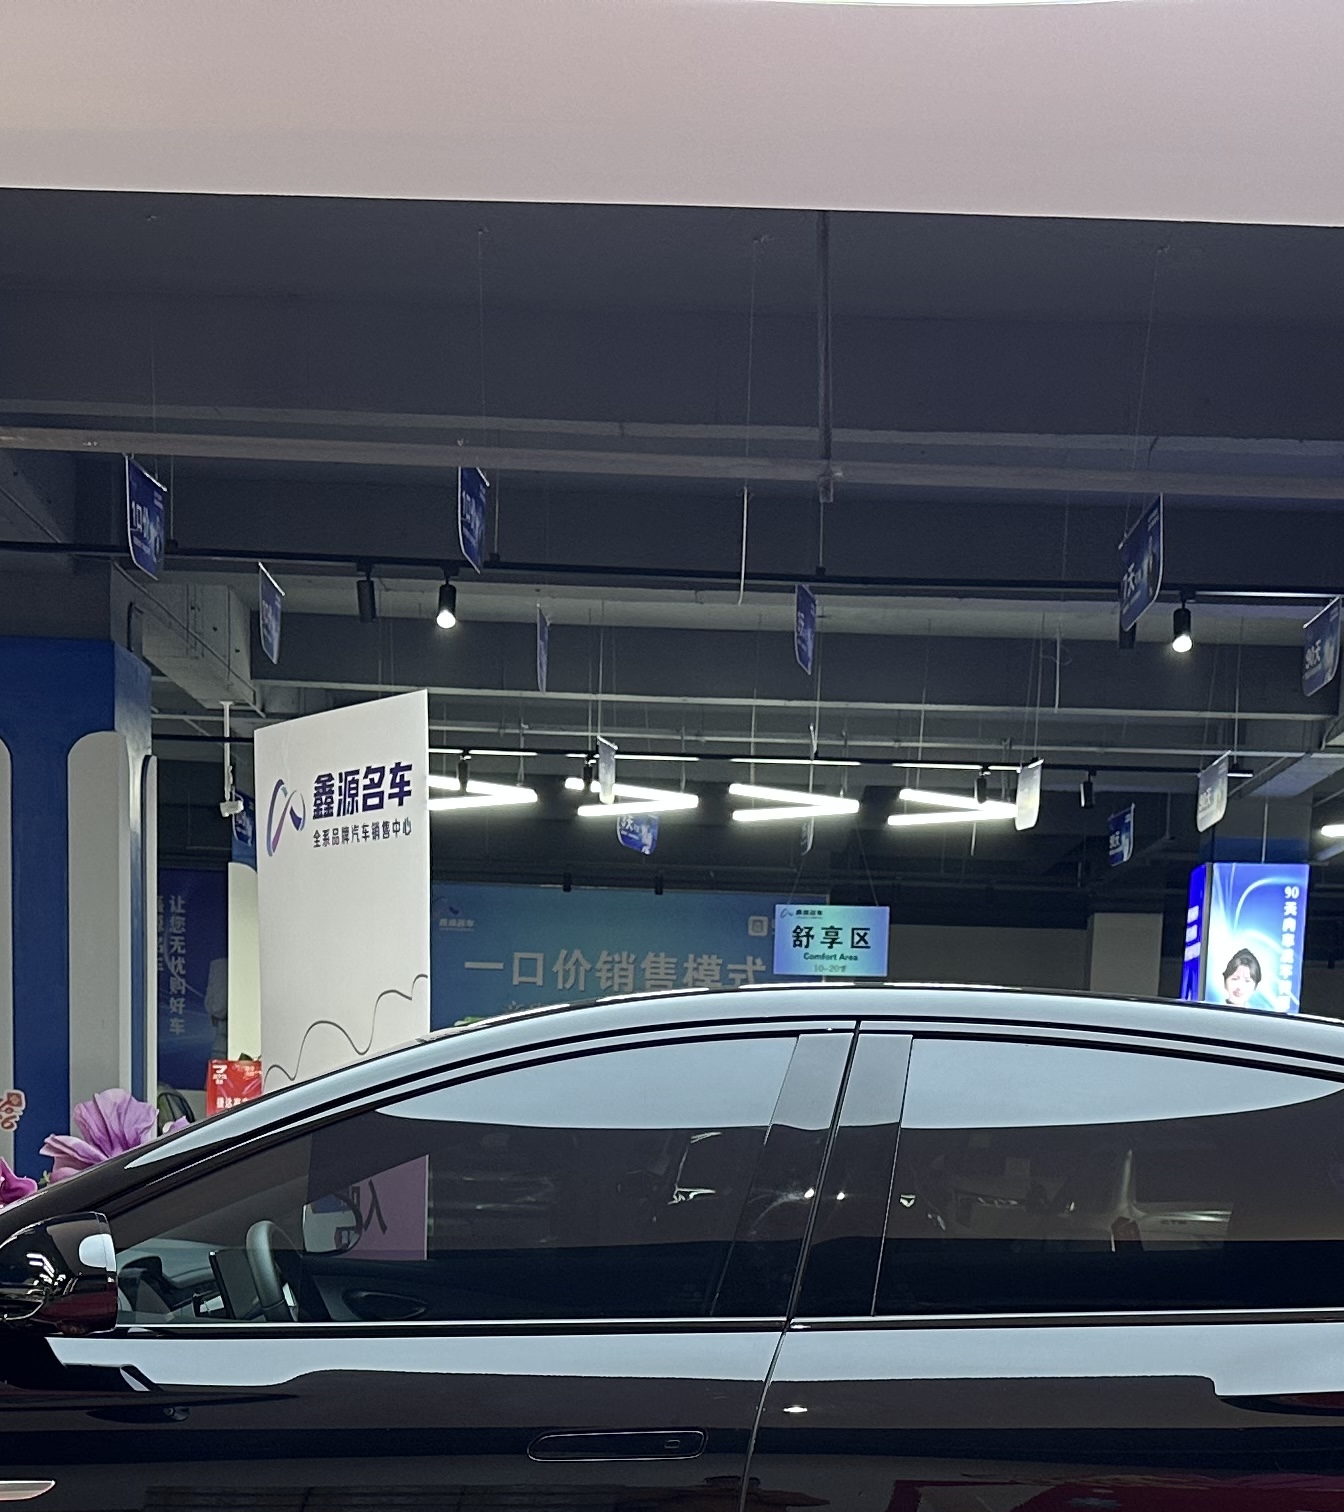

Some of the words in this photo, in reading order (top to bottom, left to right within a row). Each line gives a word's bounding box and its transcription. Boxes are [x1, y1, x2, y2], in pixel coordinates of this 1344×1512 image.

[313, 762, 413, 820] 鑫源名车
[313, 816, 412, 848] 全系品牌汽车销售中心
[792, 924, 872, 950] 舒享区
[169, 895, 187, 1036] 让您无忧购好车
[464, 949, 767, 992] 一口价销售模式
[803, 952, 838, 962] Comfort
[839, 953, 859, 962] Area
